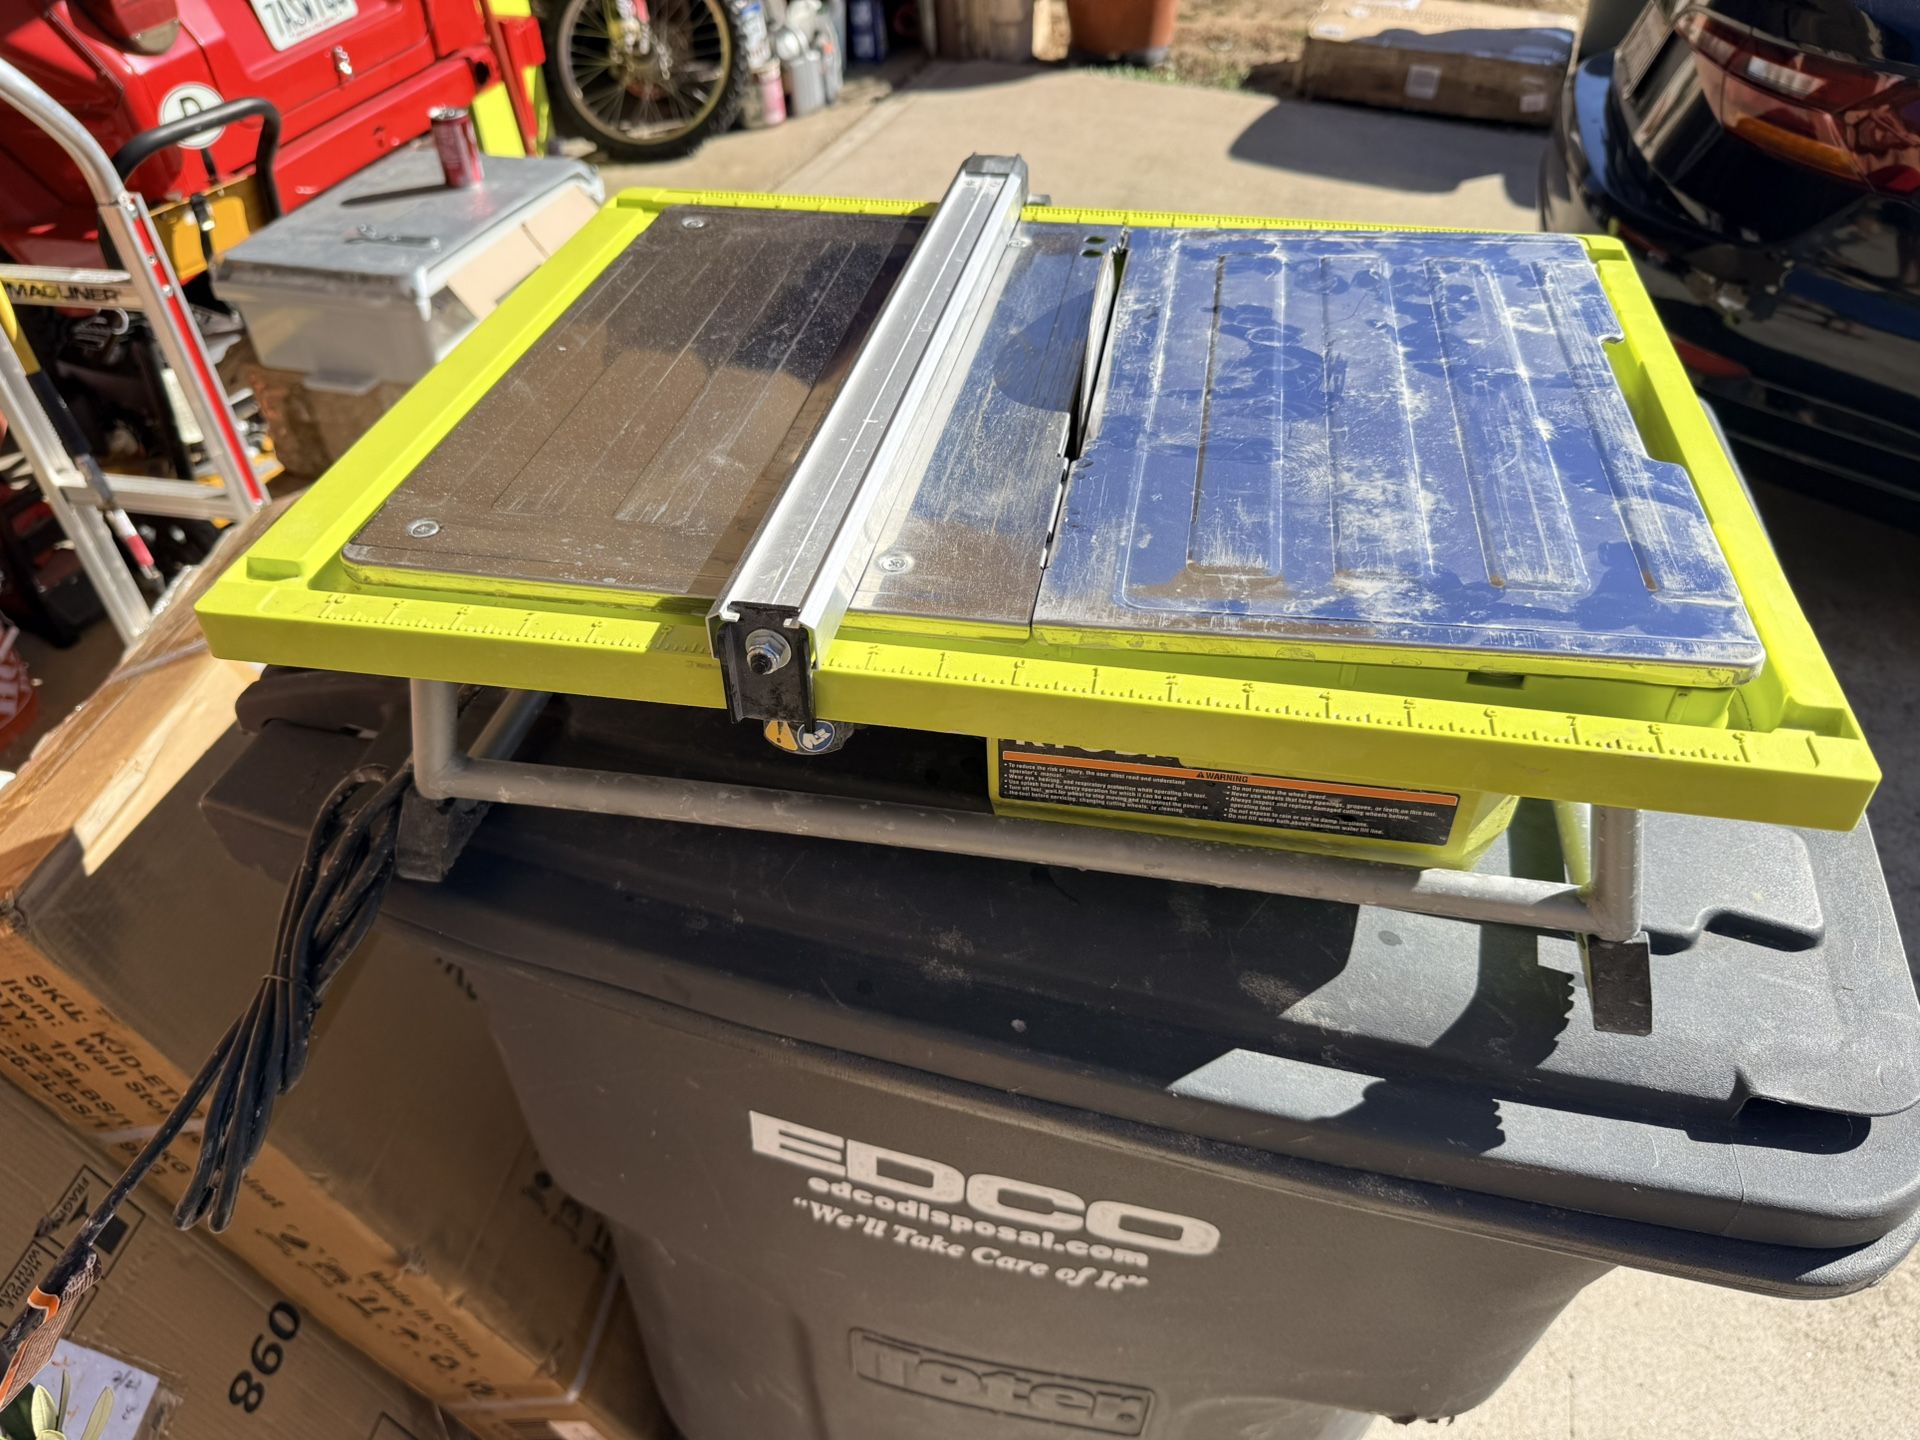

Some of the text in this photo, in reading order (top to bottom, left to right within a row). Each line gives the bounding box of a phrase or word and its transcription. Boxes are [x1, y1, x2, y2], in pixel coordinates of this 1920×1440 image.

[1318, 690, 1332, 701] 4
[1565, 714, 1577, 727] 7
[1206, 772, 1248, 784] WARNING
[0, 979, 65, 1028] Item:
[75, 1038, 129, 1077] Wall
[0, 996, 38, 1030] TY:
[50, 1040, 91, 1073] 1pc
[25, 974, 89, 1023] SKU:
[749, 1110, 1221, 1255] EDCO
[808, 1177, 1149, 1268] edcodisposal.com
[893, 1223, 966, 1259] Take
[970, 1245, 1049, 1277] Care
[1055, 1265, 1097, 1288] of
[8, 1260, 43, 1308] HANDLE
[229, 1300, 302, 1416] 860
[858, 1335, 1144, 1430] Toter
